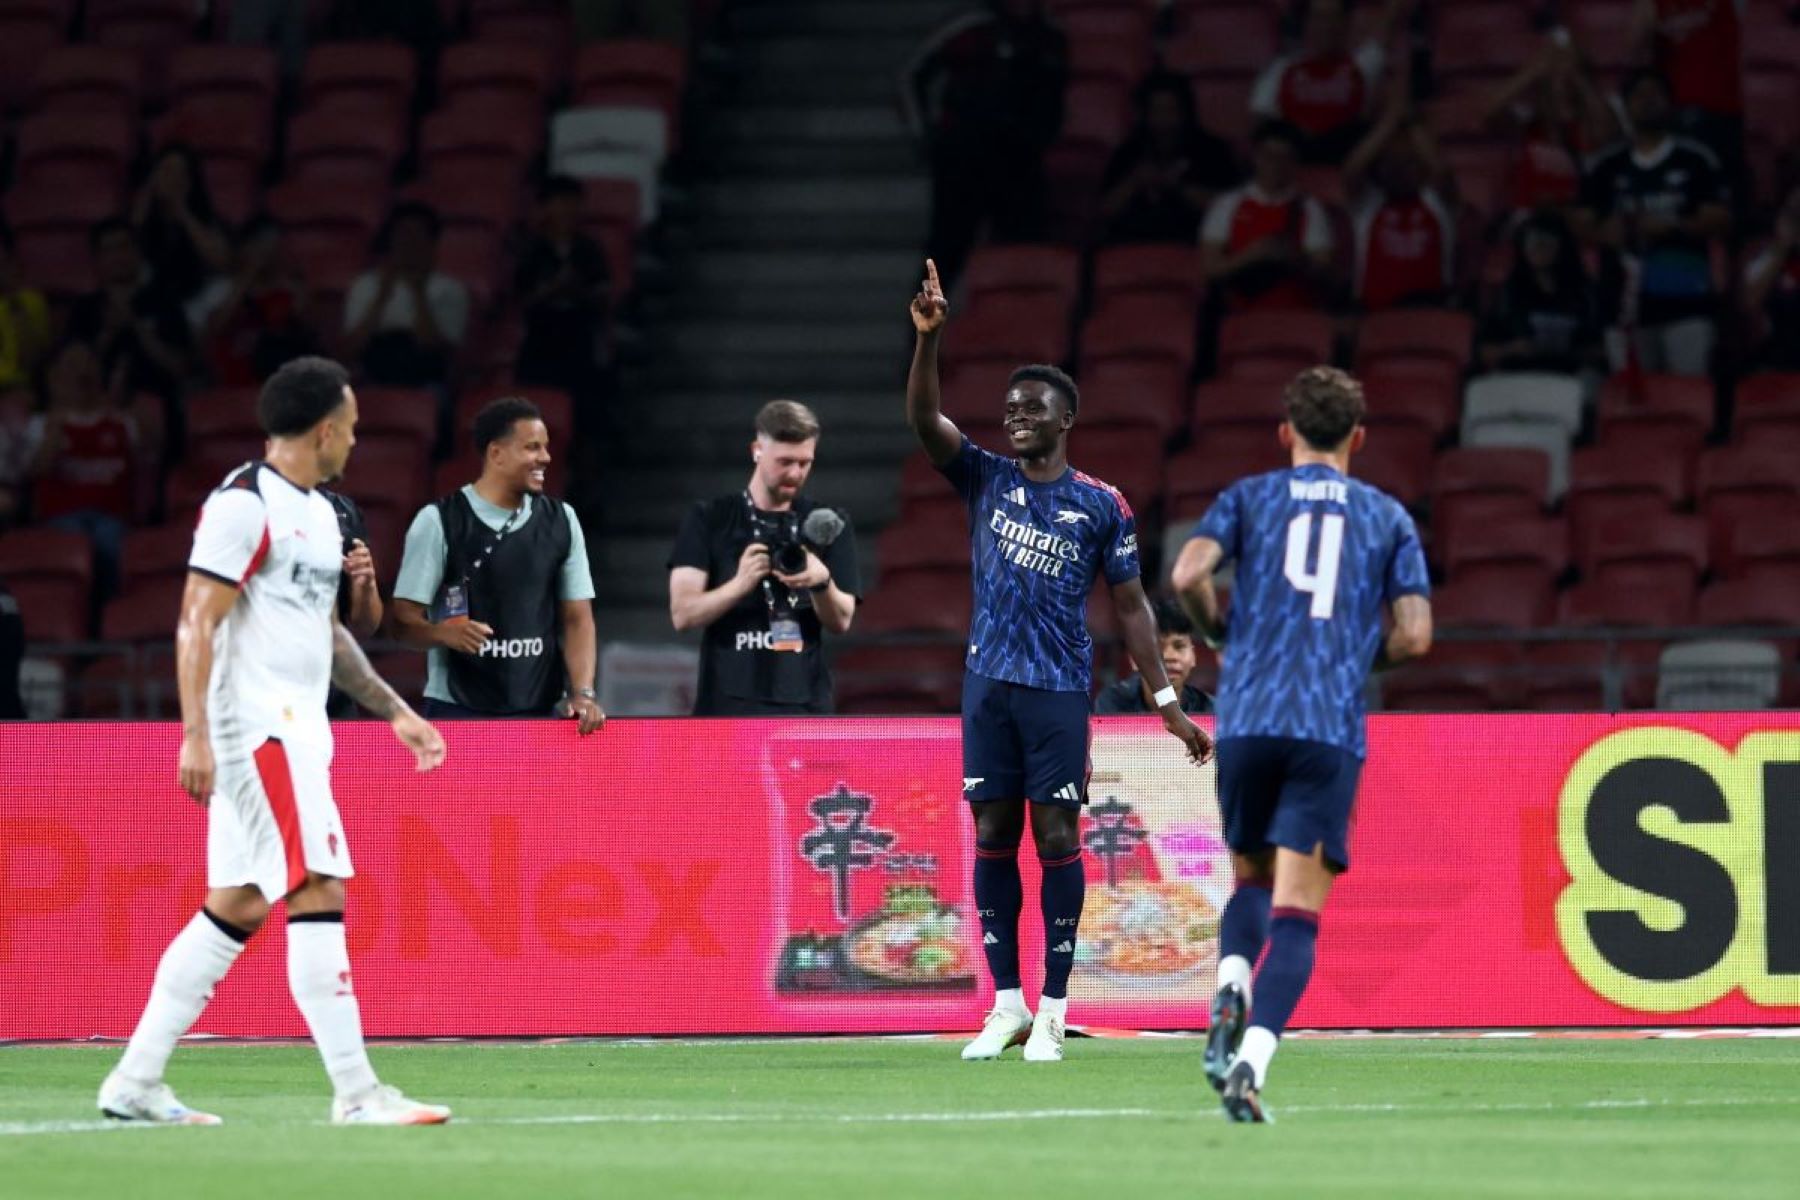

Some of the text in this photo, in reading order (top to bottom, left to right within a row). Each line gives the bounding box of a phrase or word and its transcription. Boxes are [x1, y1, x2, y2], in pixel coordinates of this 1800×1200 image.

[990, 509, 1080, 561] Emirates
[1013, 546, 1063, 577] BETTER
[1284, 512, 1345, 619] 4
[479, 637, 543, 658] PHOTO
[0, 813, 727, 963] PrNex
